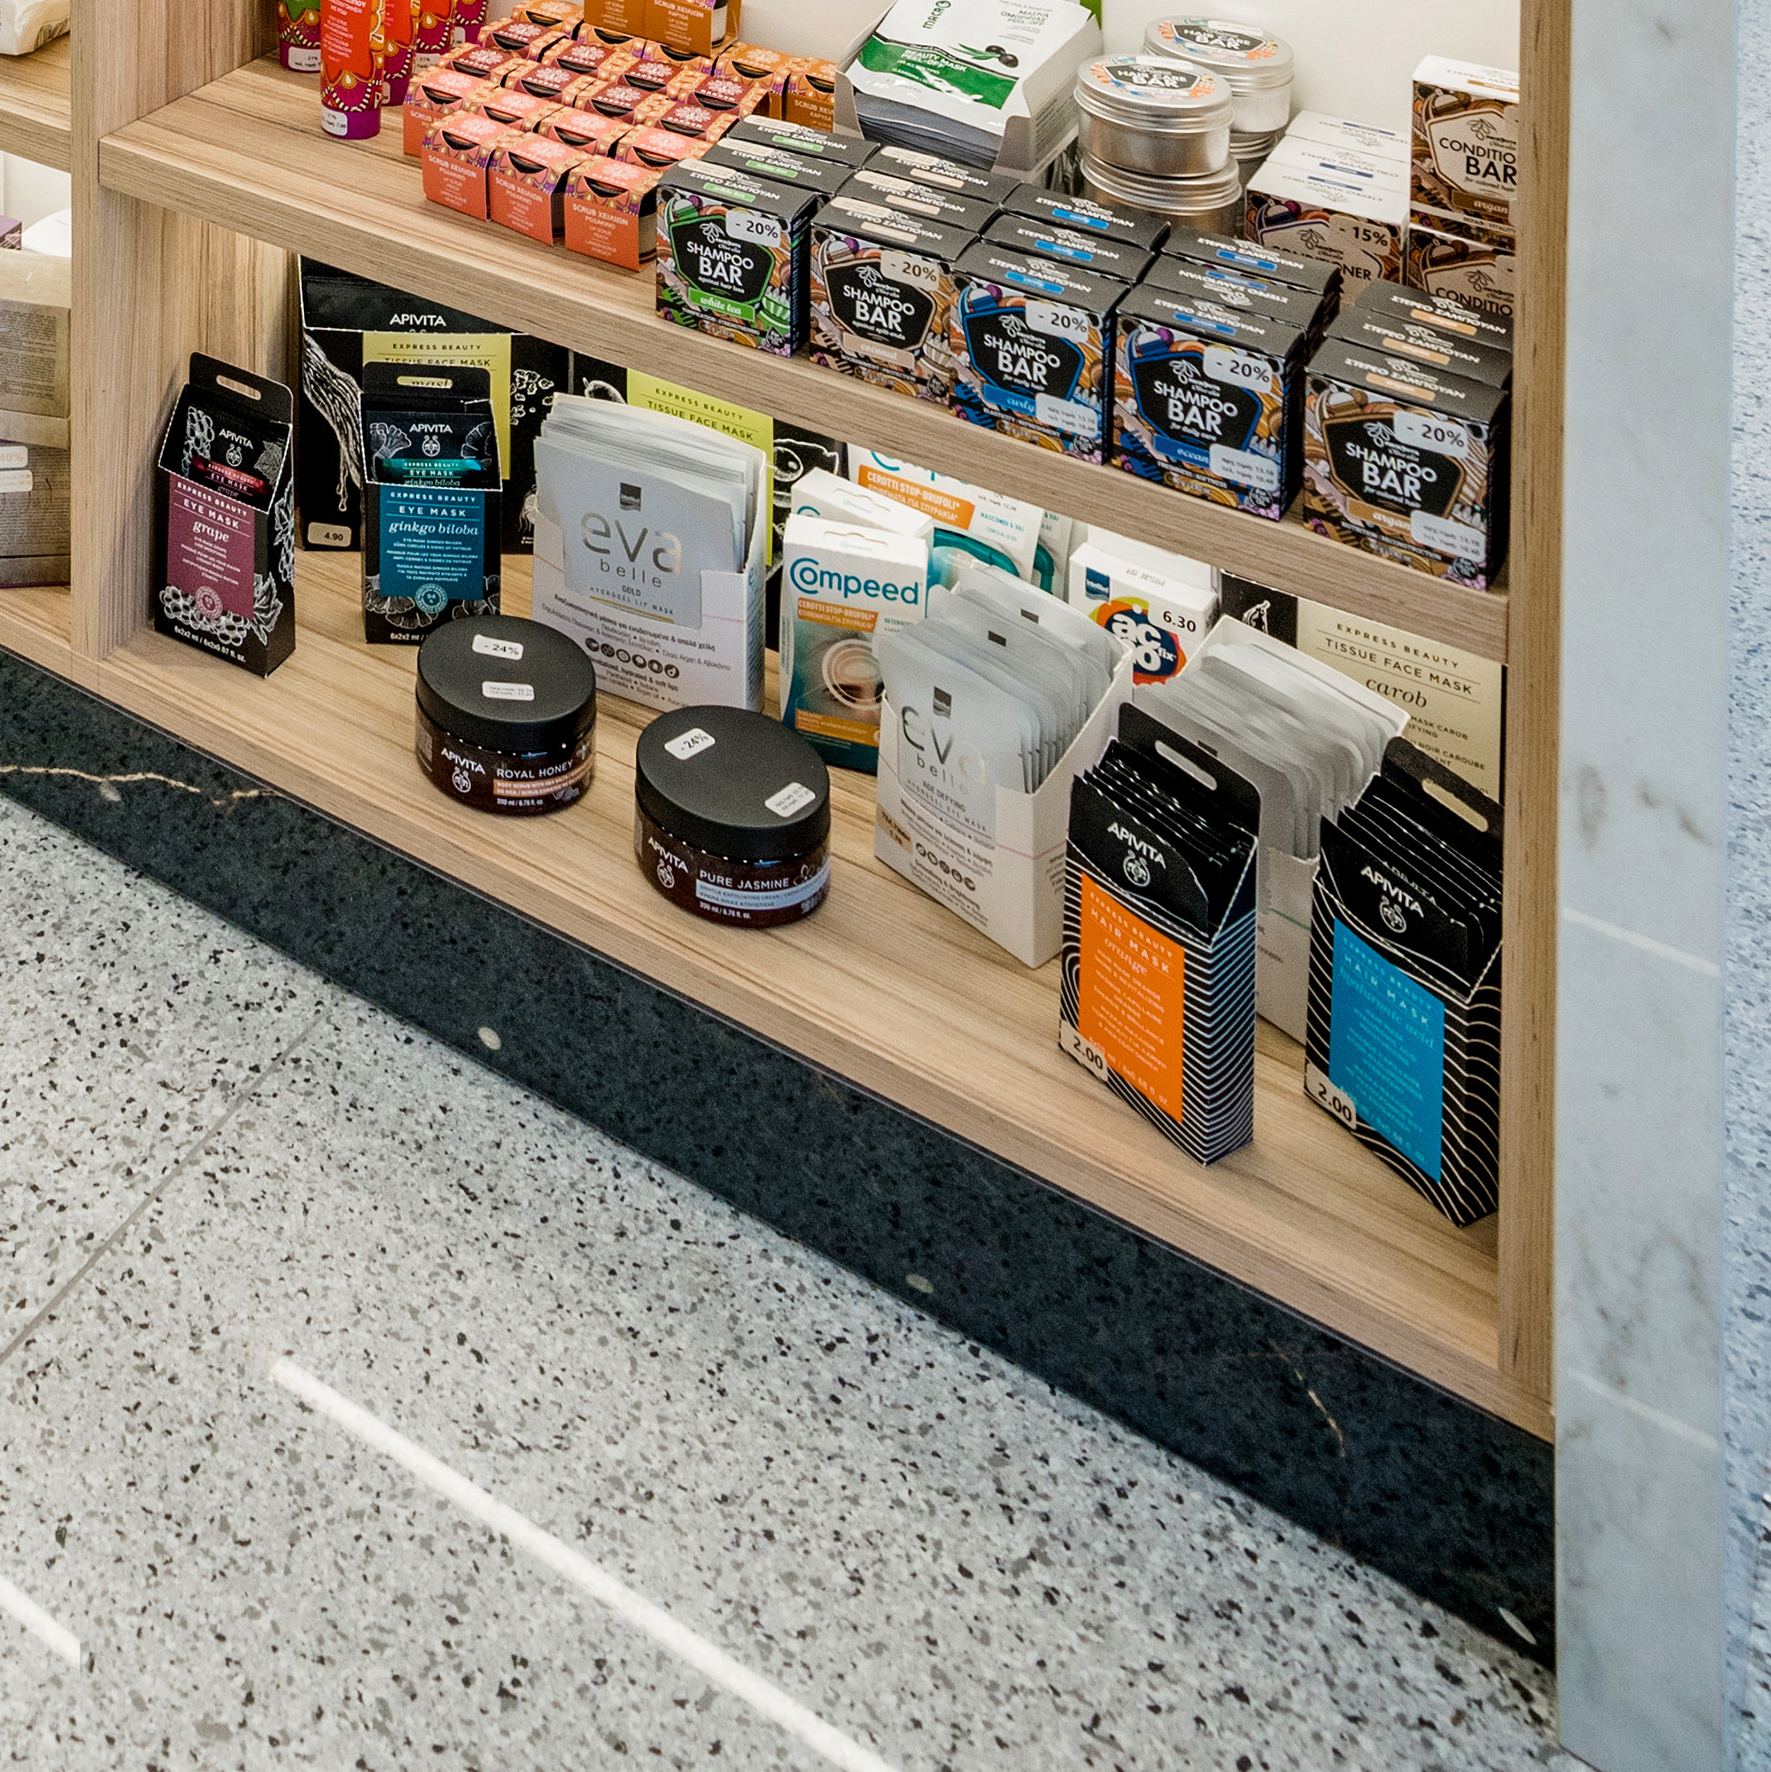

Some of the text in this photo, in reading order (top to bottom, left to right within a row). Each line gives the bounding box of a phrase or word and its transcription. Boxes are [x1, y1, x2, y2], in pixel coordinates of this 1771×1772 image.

[1439, 137, 1516, 165] CONDITIO
[1465, 157, 1517, 185] BAR
[687, 241, 754, 269] SHAMPOO
[699, 259, 743, 287] BAR
[843, 285, 915, 316] SHAMPOO
[390, 313, 446, 327] APIVITA
[855, 302, 902, 333] BAR
[393, 343, 437, 351] EXPRESS
[983, 334, 1061, 368] SHAMPOO
[998, 352, 1048, 385] BAR
[655, 387, 744, 421] EXPRESS BEAUTY
[1153, 381, 1238, 417] SHAMPOO
[409, 423, 453, 434] APIVITA
[648, 400, 754, 441] TISSUE FACE MASK
[1168, 400, 1223, 435] BAR
[218, 428, 253, 450] APIVITA
[1345, 441, 1437, 483] SHAMPOO
[390, 492, 476, 502] EXPRESS BEAUTY
[1362, 463, 1422, 501] BAR
[183, 498, 240, 529] EYE MASK
[399, 505, 466, 516] EYE MASK
[192, 520, 230, 543] grape
[324, 532, 344, 541] 4.90
[388, 519, 479, 537] ginkgo biloba
[581, 511, 683, 575] eva
[600, 557, 662, 589] belle
[790, 557, 920, 605] Compeed
[1162, 609, 1197, 633] 6.30
[1336, 622, 1460, 669] EXPRESS BEAUTY
[1325, 637, 1472, 695] TISSUE FACE MASK
[1365, 676, 1427, 708] carob
[441, 748, 486, 775] APIVITA
[496, 760, 573, 779] ROYAL HONEY
[648, 837, 689, 874] APIVITA
[1107, 822, 1166, 870] APIVITA
[700, 870, 789, 890] PURE JASMINE
[1361, 865, 1424, 919] APIVITA
[1091, 909, 1170, 975] HAIR MASK
[1073, 1036, 1104, 1071] 2.00
[1318, 1082, 1353, 1123] 2.00
